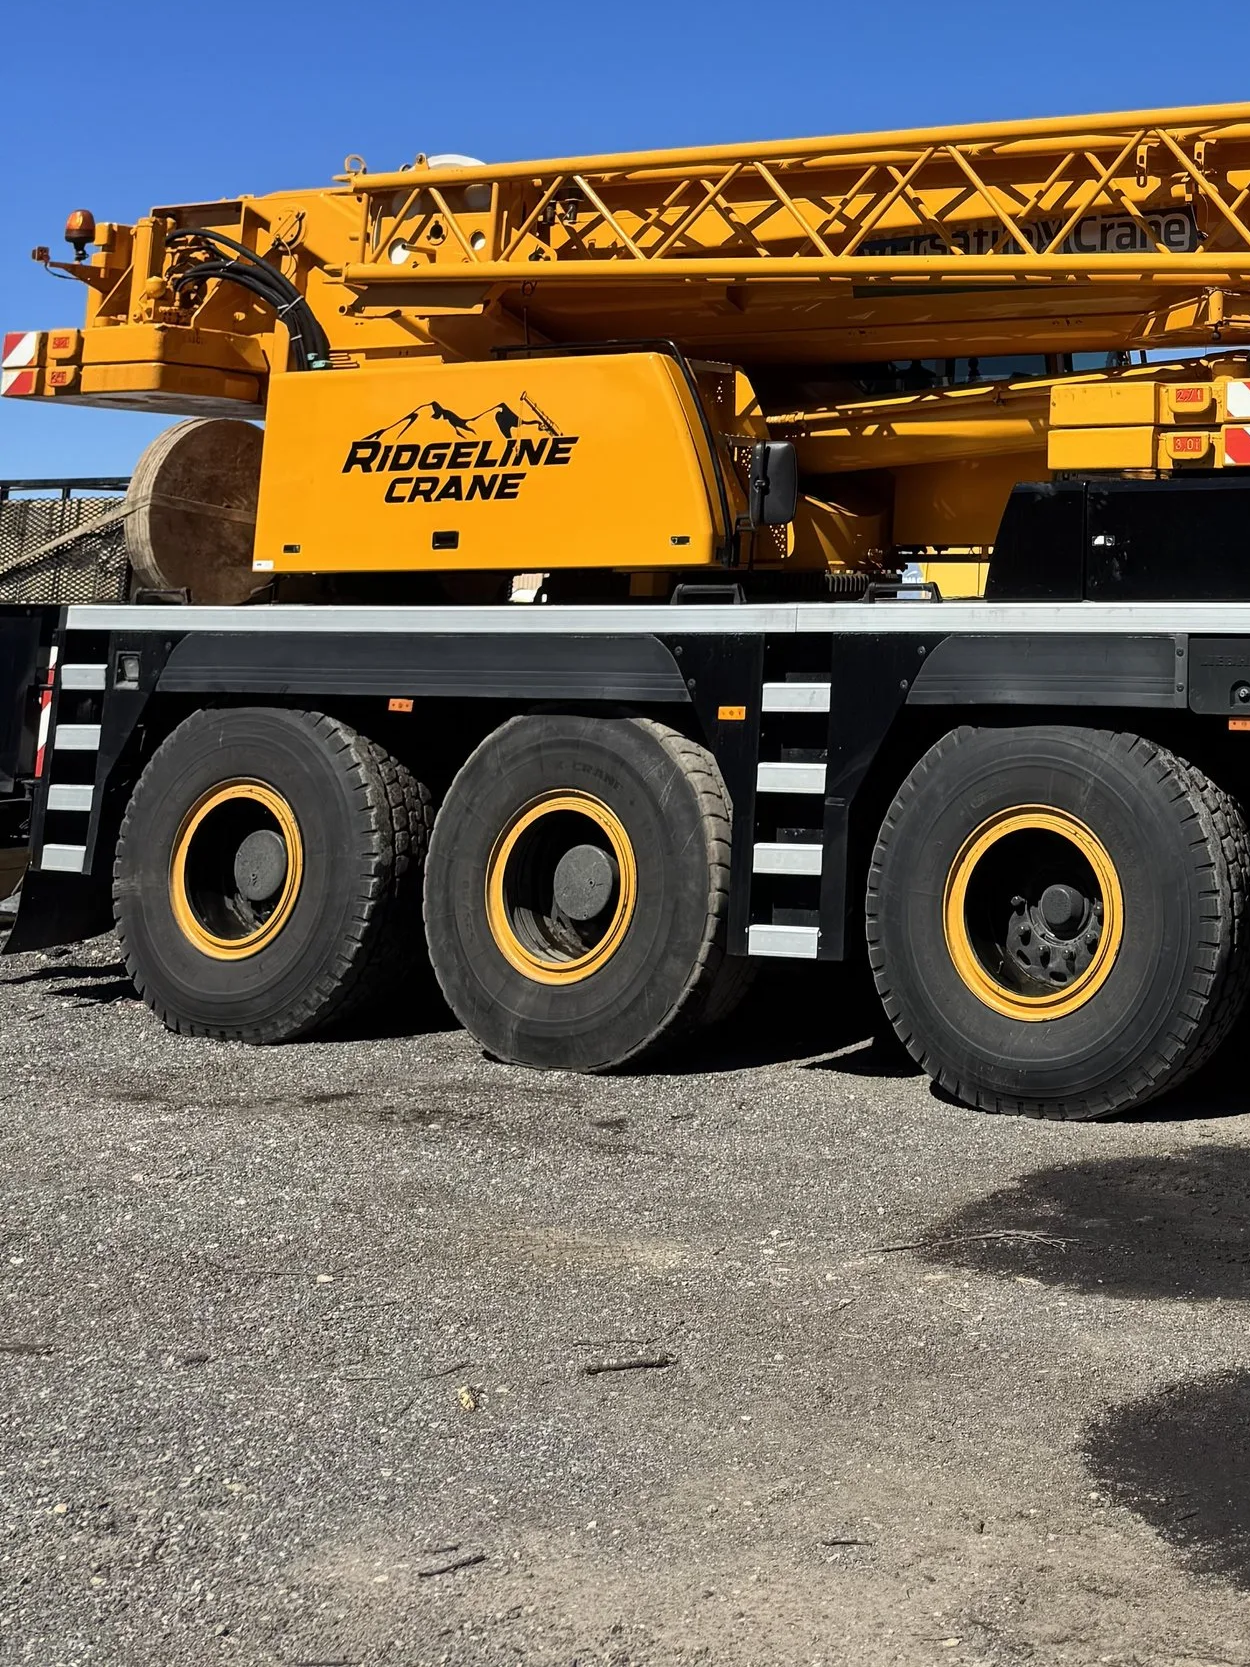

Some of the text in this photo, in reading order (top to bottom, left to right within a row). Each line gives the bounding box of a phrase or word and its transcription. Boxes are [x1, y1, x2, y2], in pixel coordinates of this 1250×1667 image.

[1073, 214, 1187, 253] Crane
[342, 436, 579, 473] RIDGELINE
[384, 472, 527, 503] CRANE
